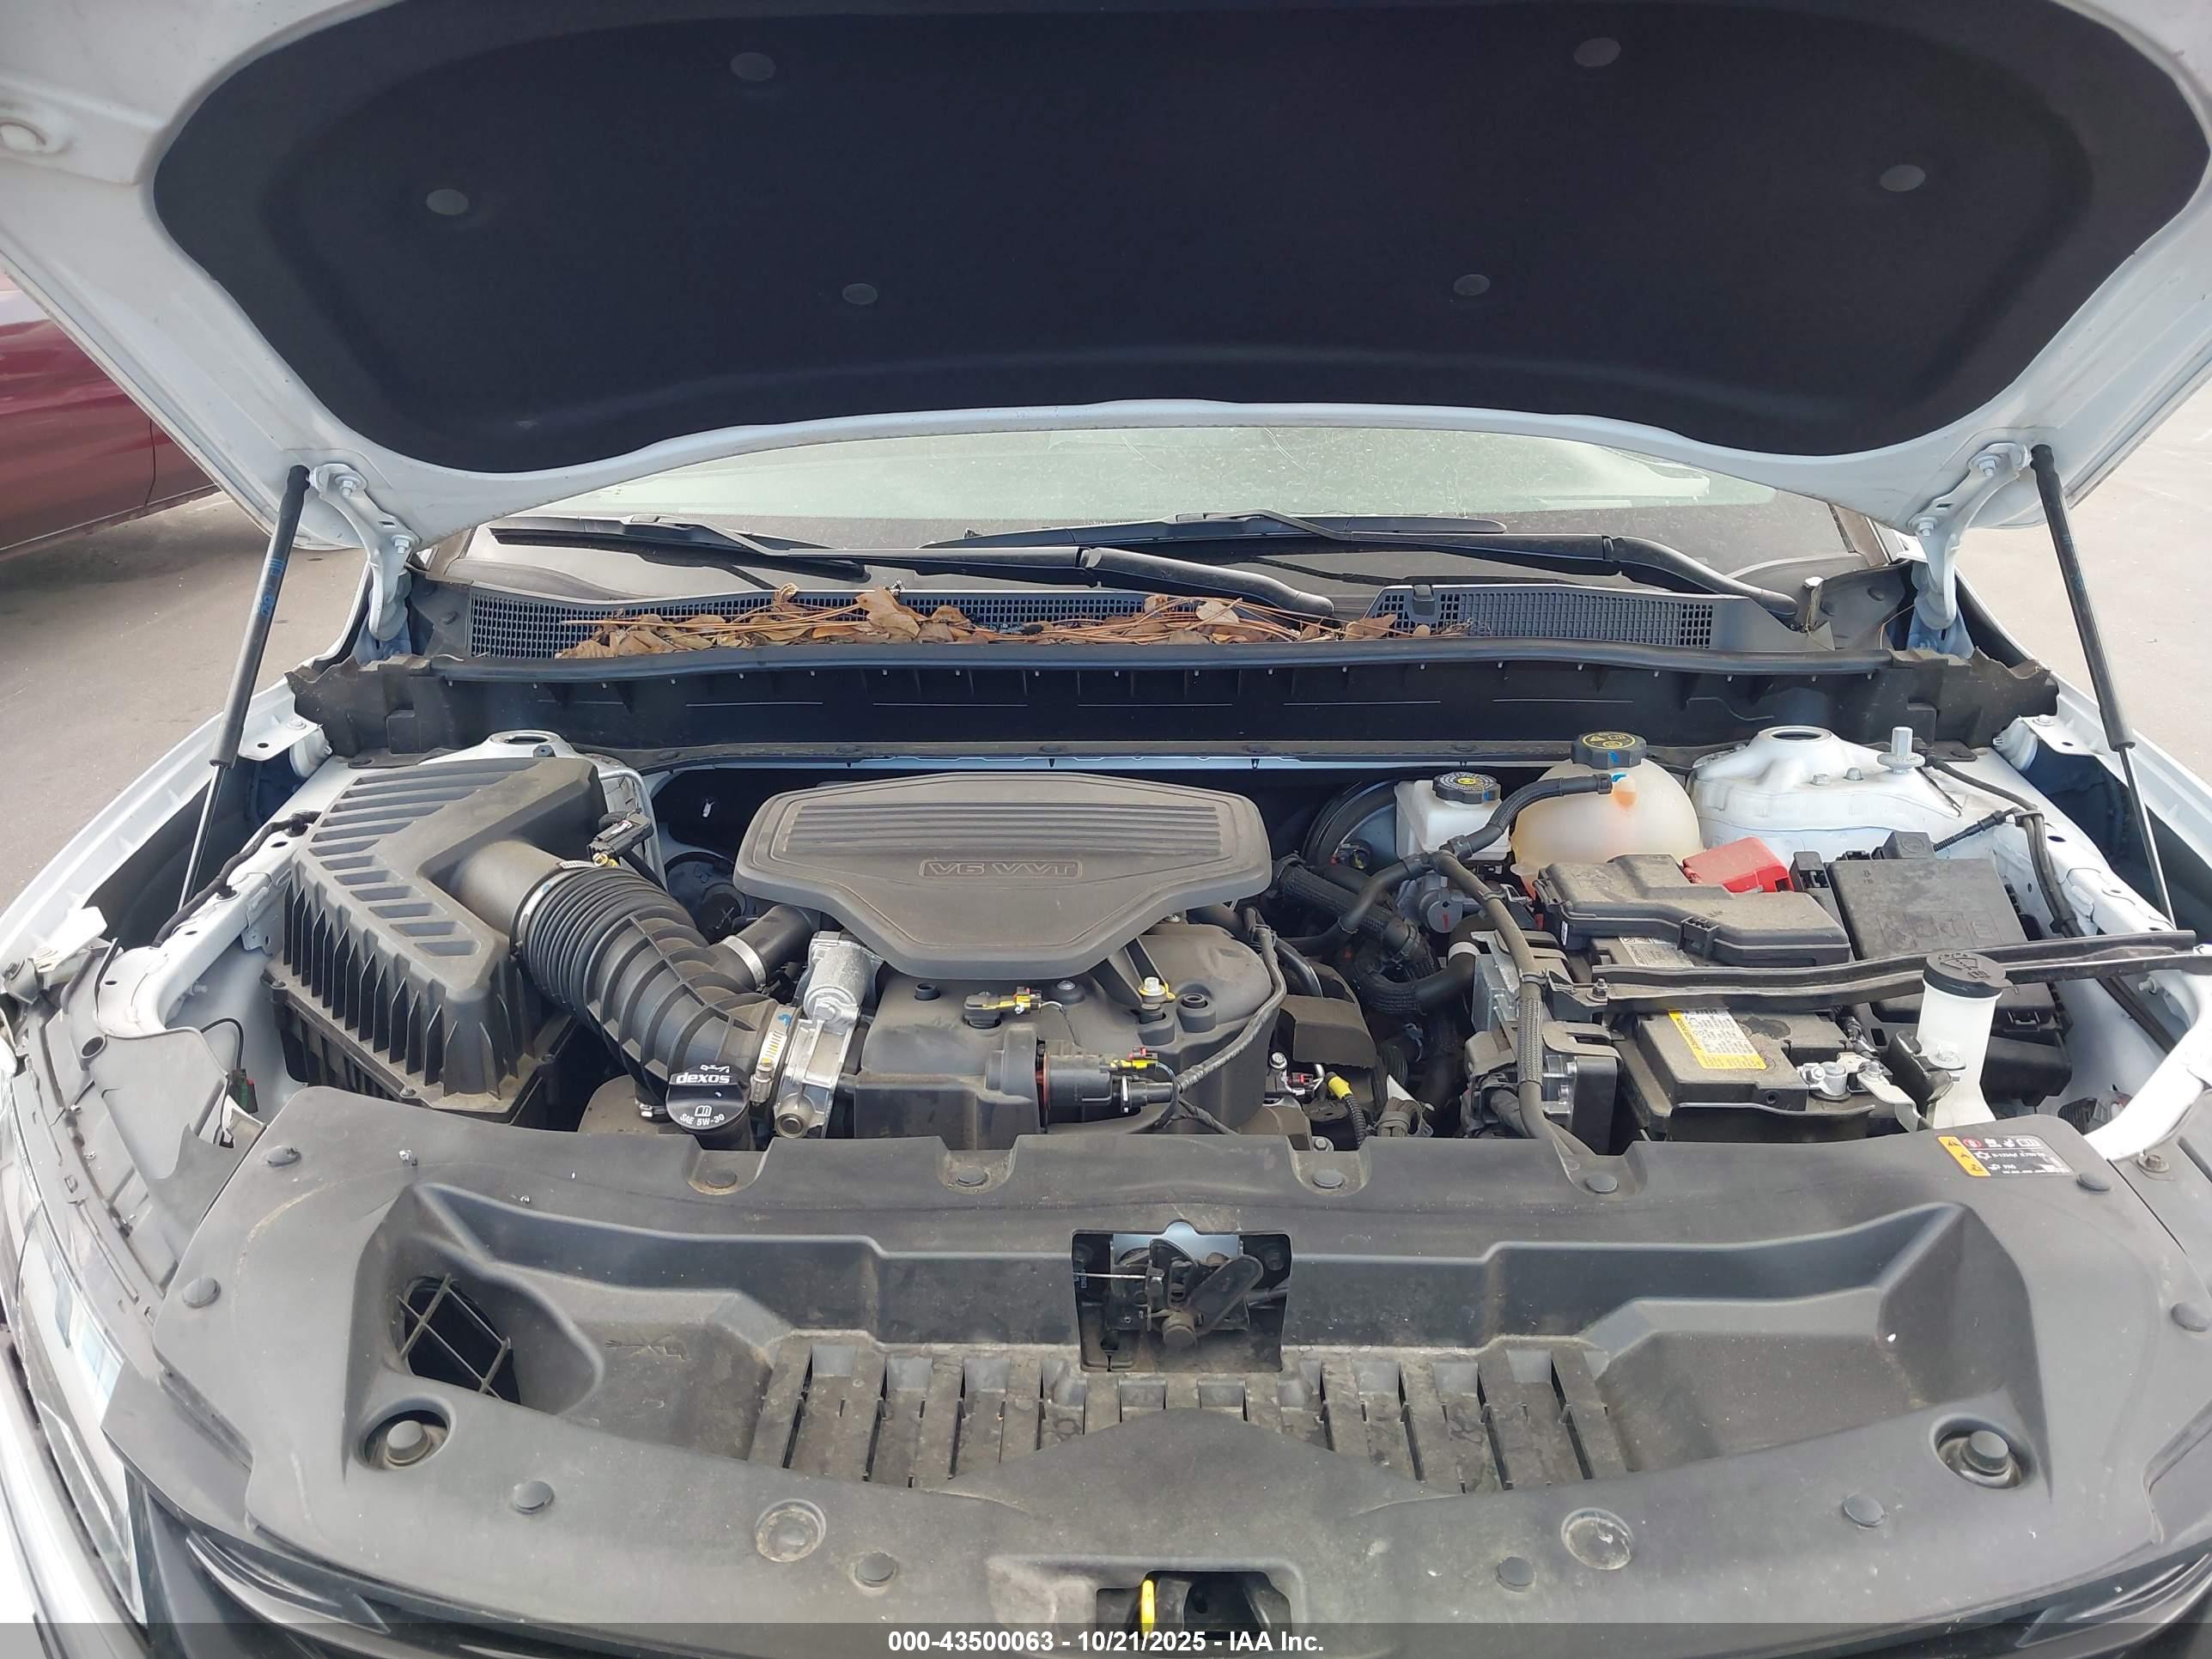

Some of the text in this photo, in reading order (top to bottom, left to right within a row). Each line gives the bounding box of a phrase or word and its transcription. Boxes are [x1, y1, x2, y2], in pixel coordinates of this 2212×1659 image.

[928, 862, 1076, 875] V6 VVT
[676, 1072, 731, 1084] dexos
[679, 1113, 725, 1126] SAE 5W-30
